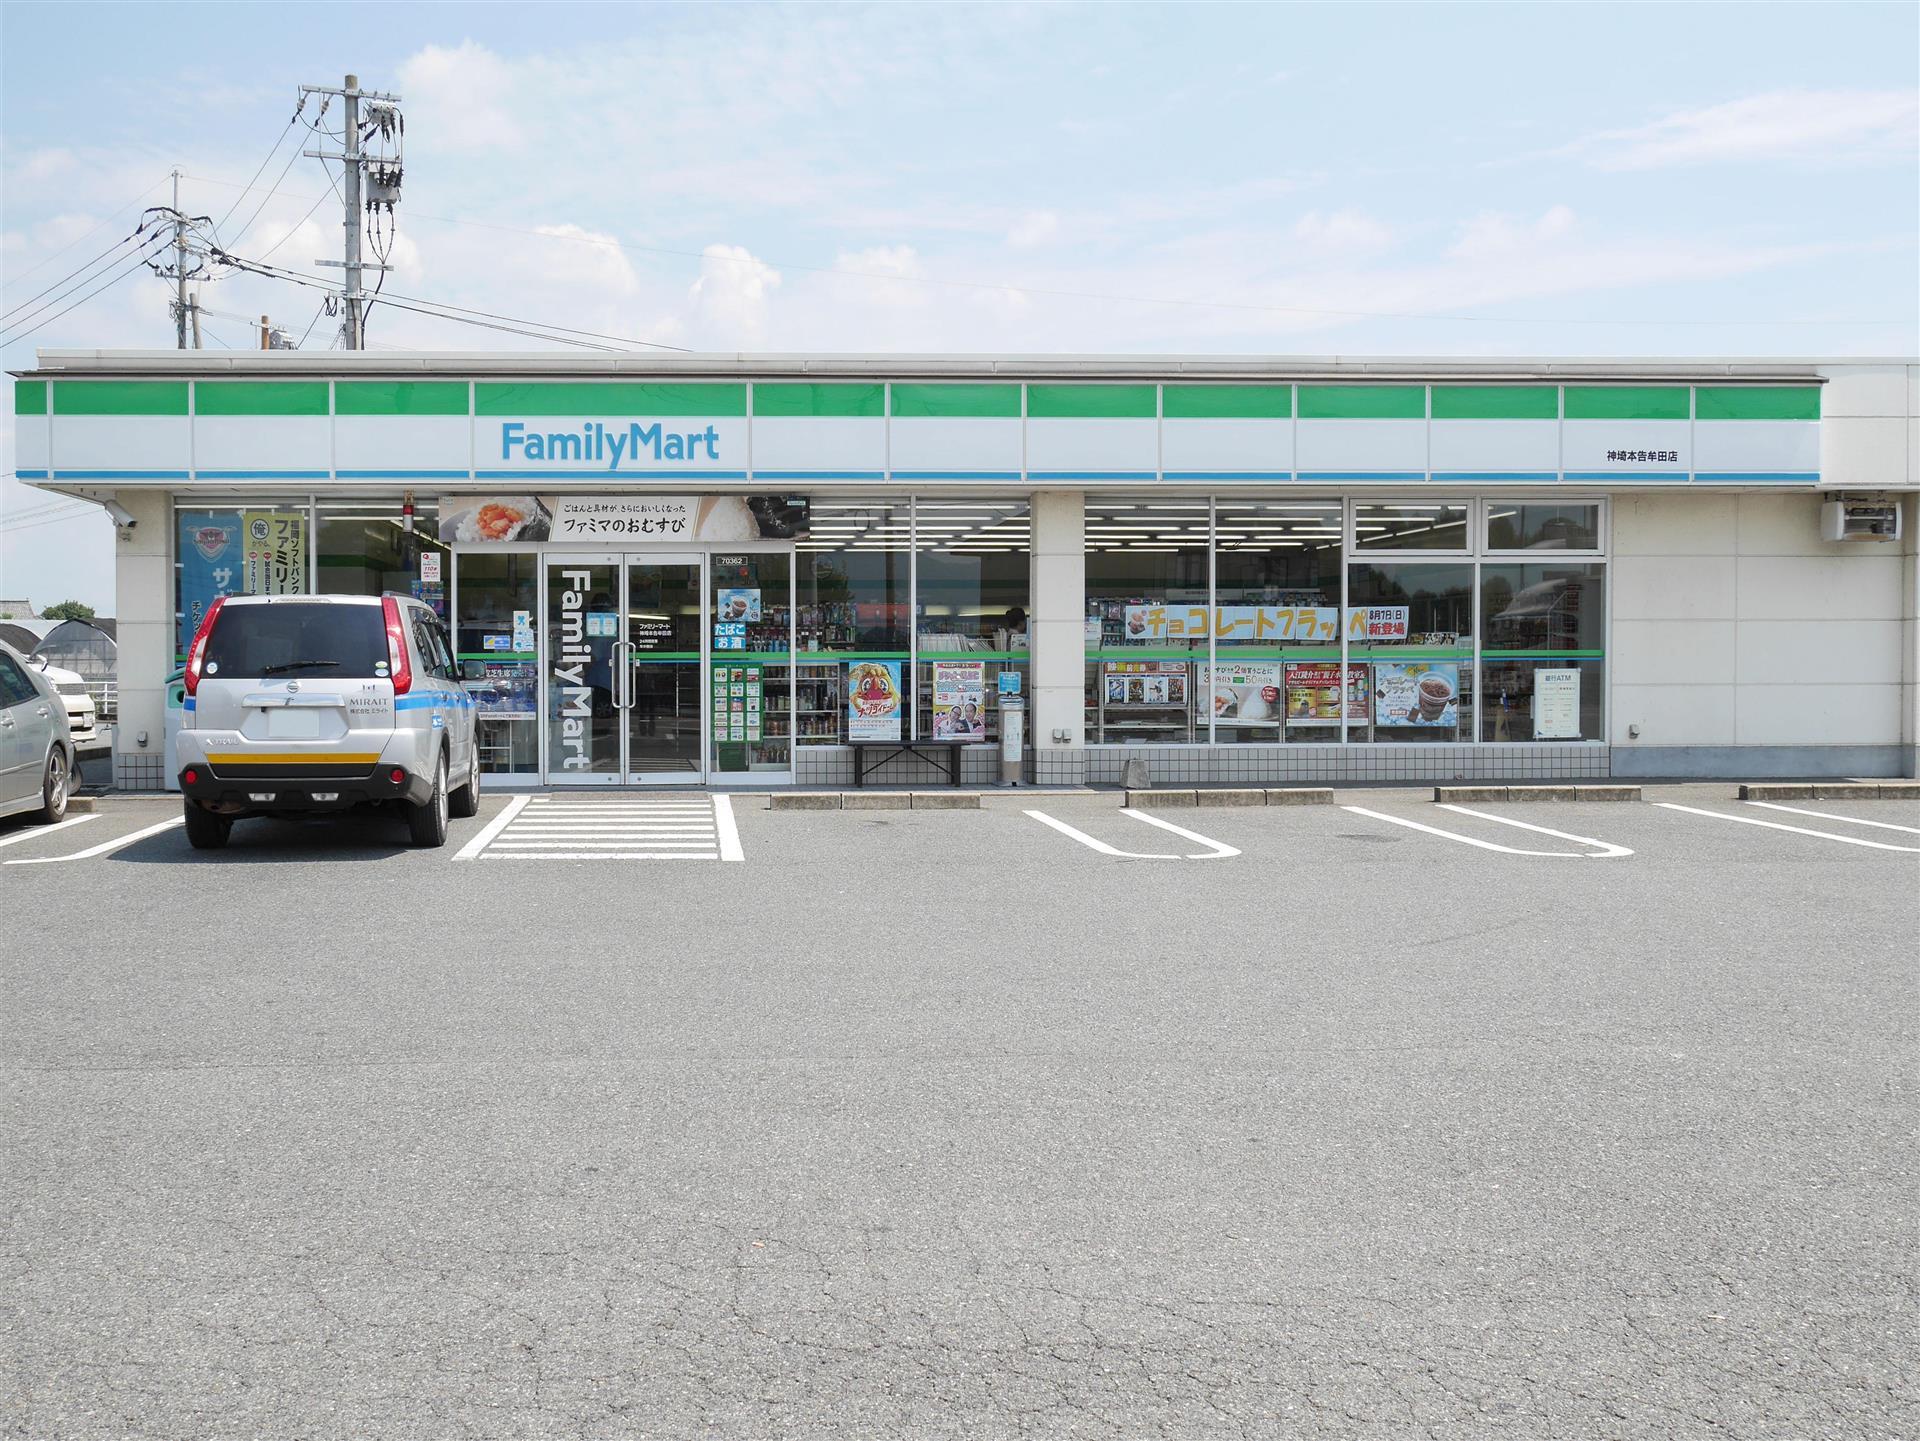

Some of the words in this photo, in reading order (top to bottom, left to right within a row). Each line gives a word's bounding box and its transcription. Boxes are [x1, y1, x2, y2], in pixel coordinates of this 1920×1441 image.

[502, 422, 719, 470] FamilyMart
[563, 504, 686, 513] ごはんと具材が、さらにおいしくなった
[253, 522, 266, 536] 俺
[564, 517, 686, 534] ファミマのおむすび
[721, 557, 743, 565] 70362
[192, 600, 201, 634] チケッ
[1148, 606, 1367, 640] チョコレートフラッペ
[715, 624, 746, 636] たばこ
[1369, 622, 1405, 635] 新登場
[718, 636, 742, 648] お酒
[554, 570, 592, 769] FamilyMart
[350, 698, 388, 706] MIRAIT
